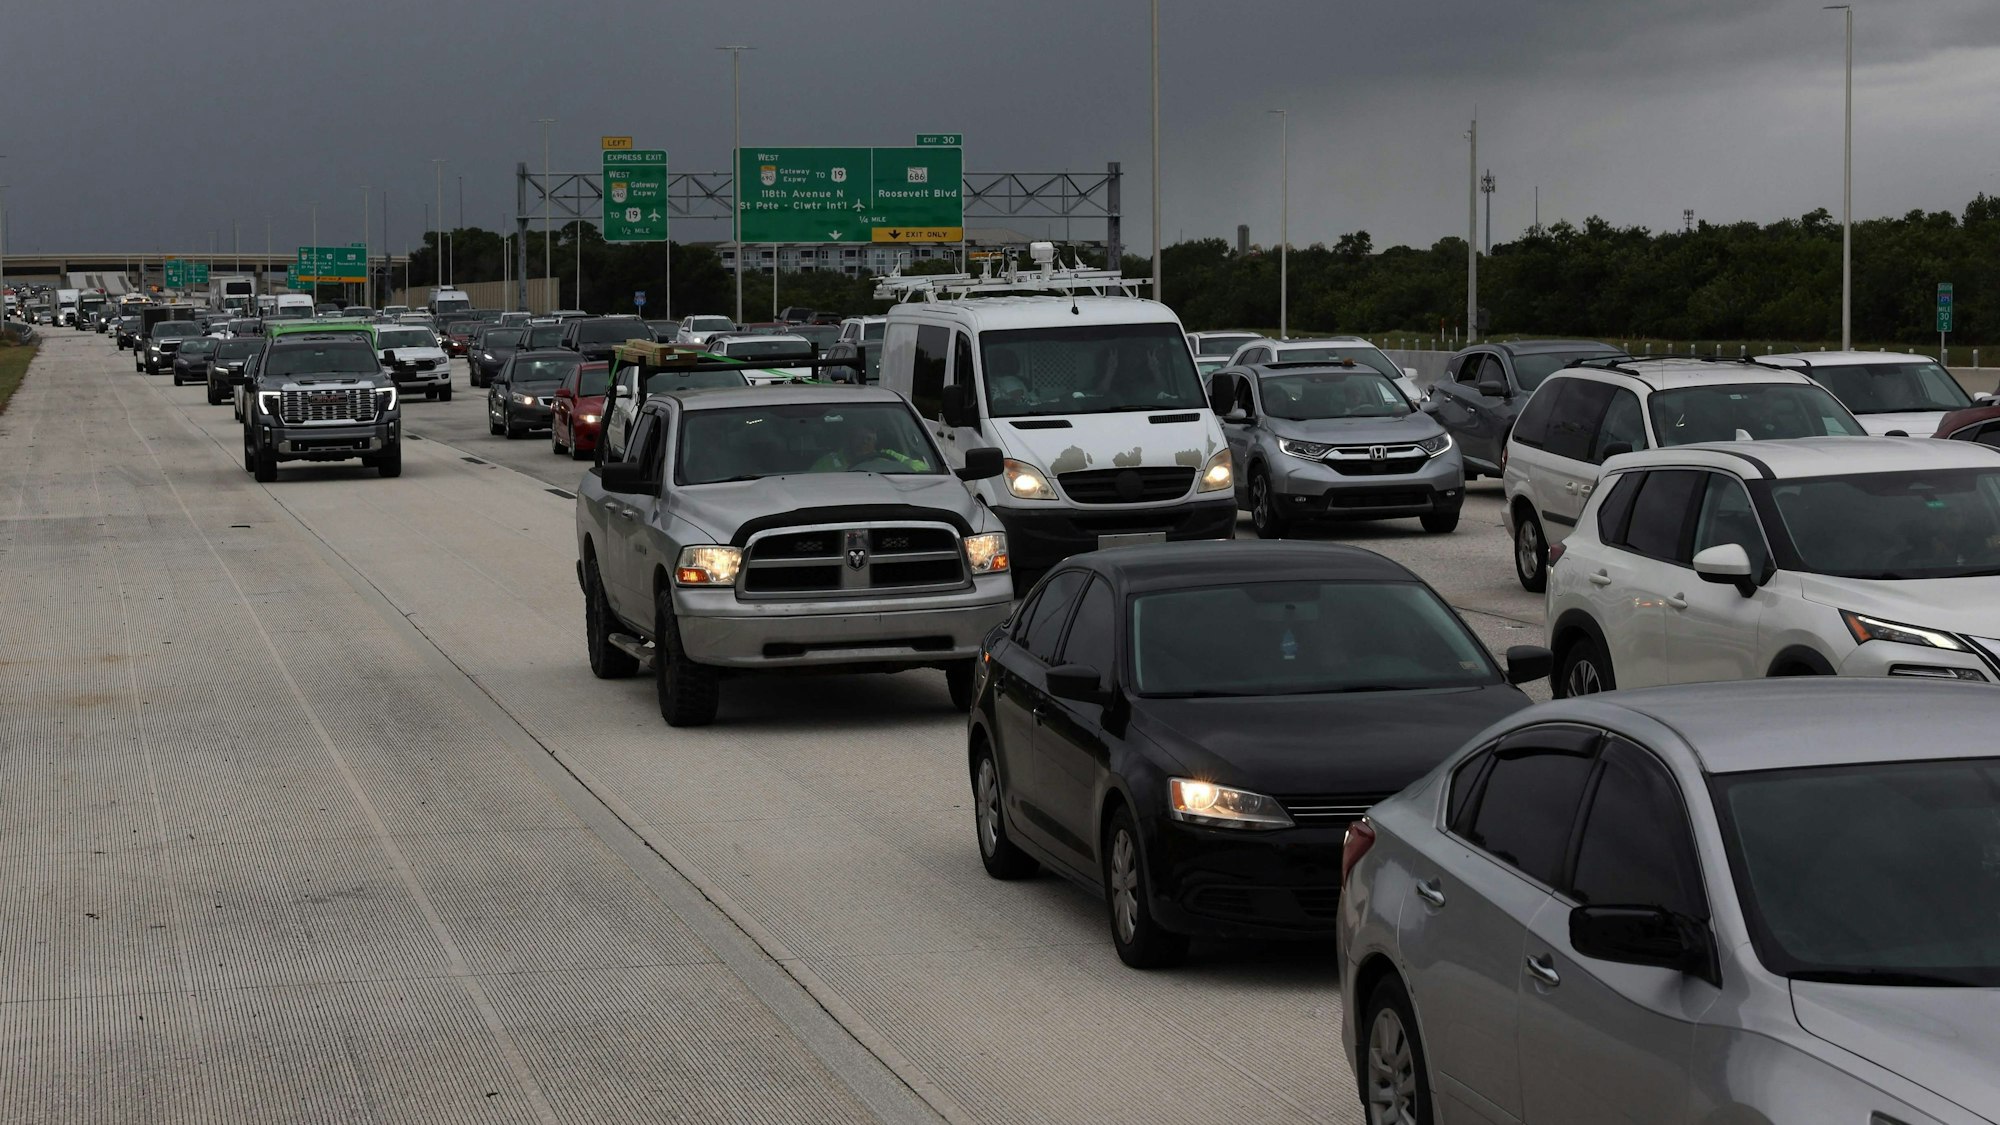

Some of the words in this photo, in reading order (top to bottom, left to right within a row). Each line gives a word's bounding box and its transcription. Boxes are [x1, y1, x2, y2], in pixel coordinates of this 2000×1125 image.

[878, 190, 929, 198] Roosevelt
[934, 190, 957, 198] Blvd
[629, 210, 638, 218] 19
